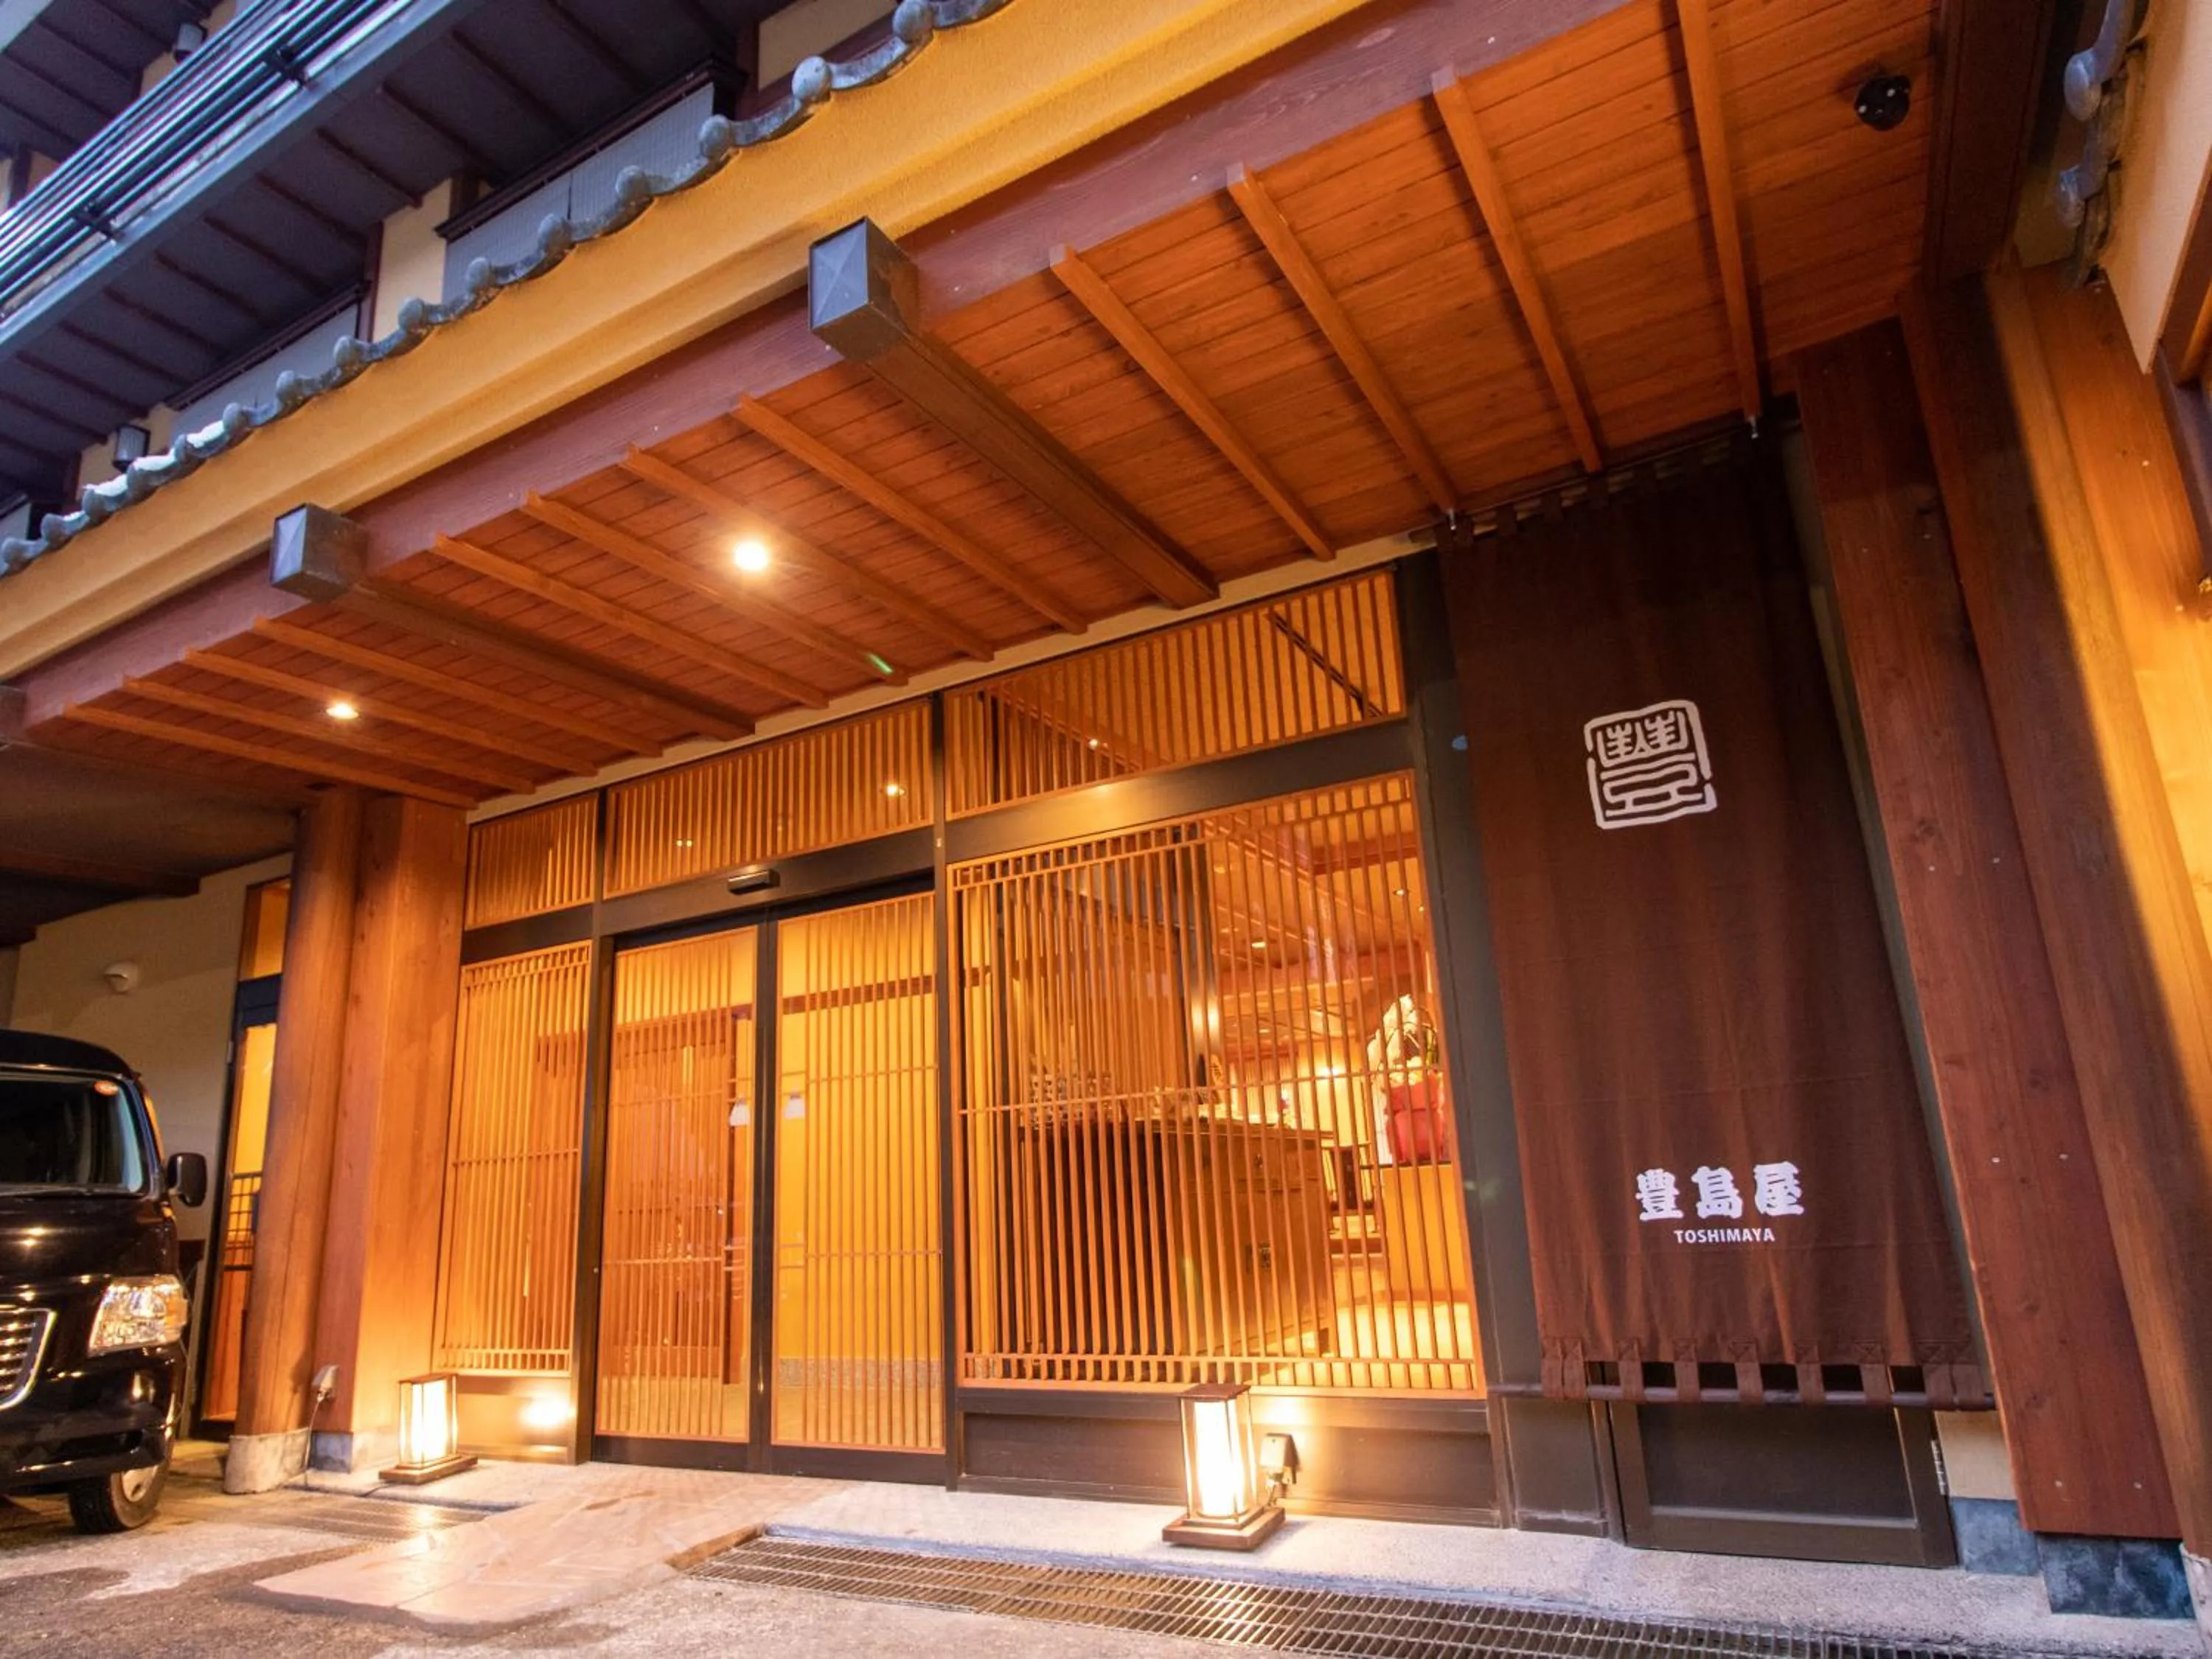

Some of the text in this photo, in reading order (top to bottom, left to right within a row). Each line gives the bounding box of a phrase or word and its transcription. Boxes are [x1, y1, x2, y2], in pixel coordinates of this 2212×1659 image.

[1635, 1161, 1805, 1222] 豊島屋
[1673, 1228, 1775, 1244] TOSHIMAYA
